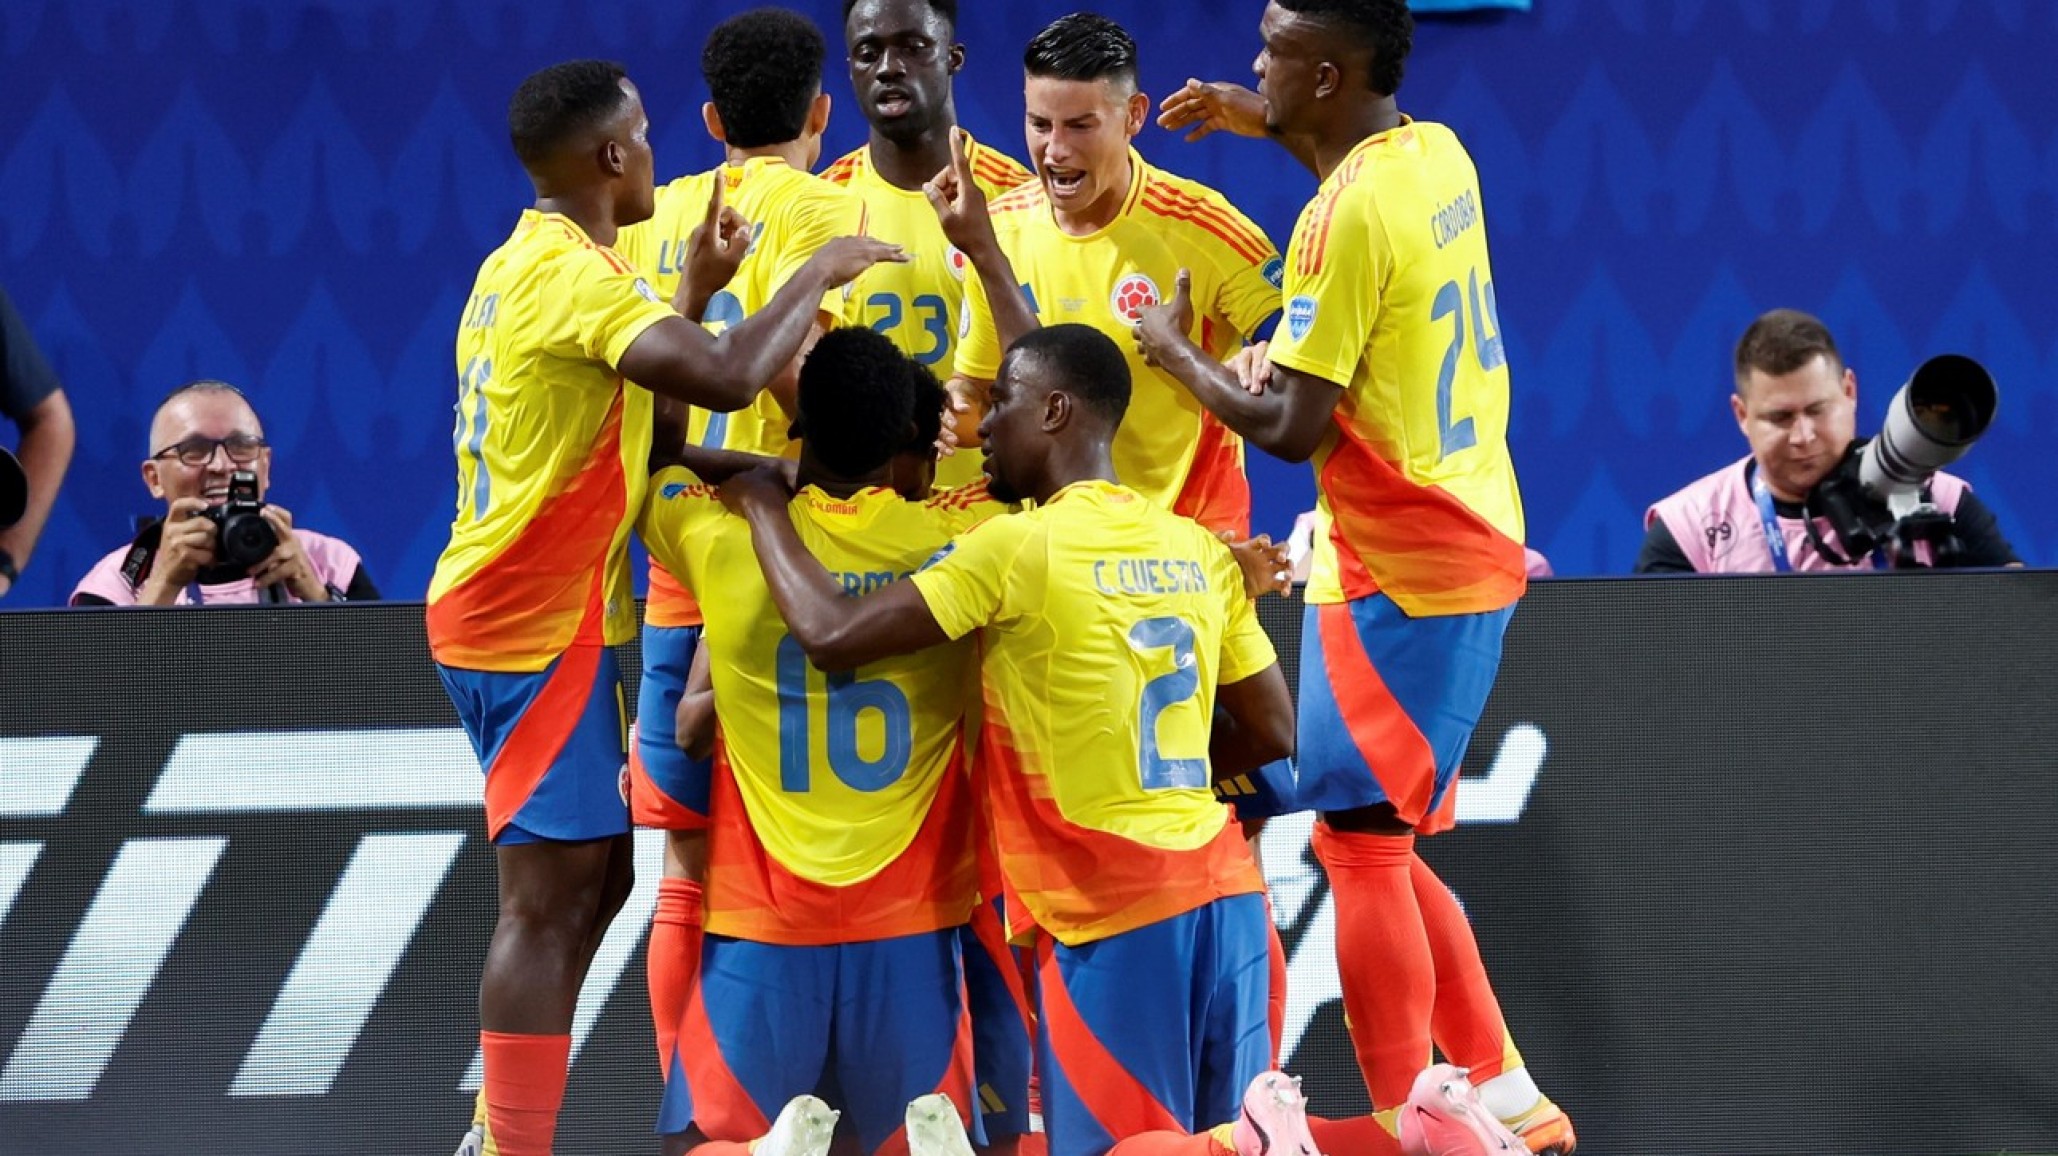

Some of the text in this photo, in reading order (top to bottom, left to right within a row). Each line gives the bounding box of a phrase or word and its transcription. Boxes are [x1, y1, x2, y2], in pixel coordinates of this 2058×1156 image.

[1431, 188, 1477, 250] CÓRDOBA
[867, 292, 950, 365] 23
[1430, 266, 1507, 463] 24
[776, 632, 912, 792] 16
[1128, 616, 1210, 790] 2
